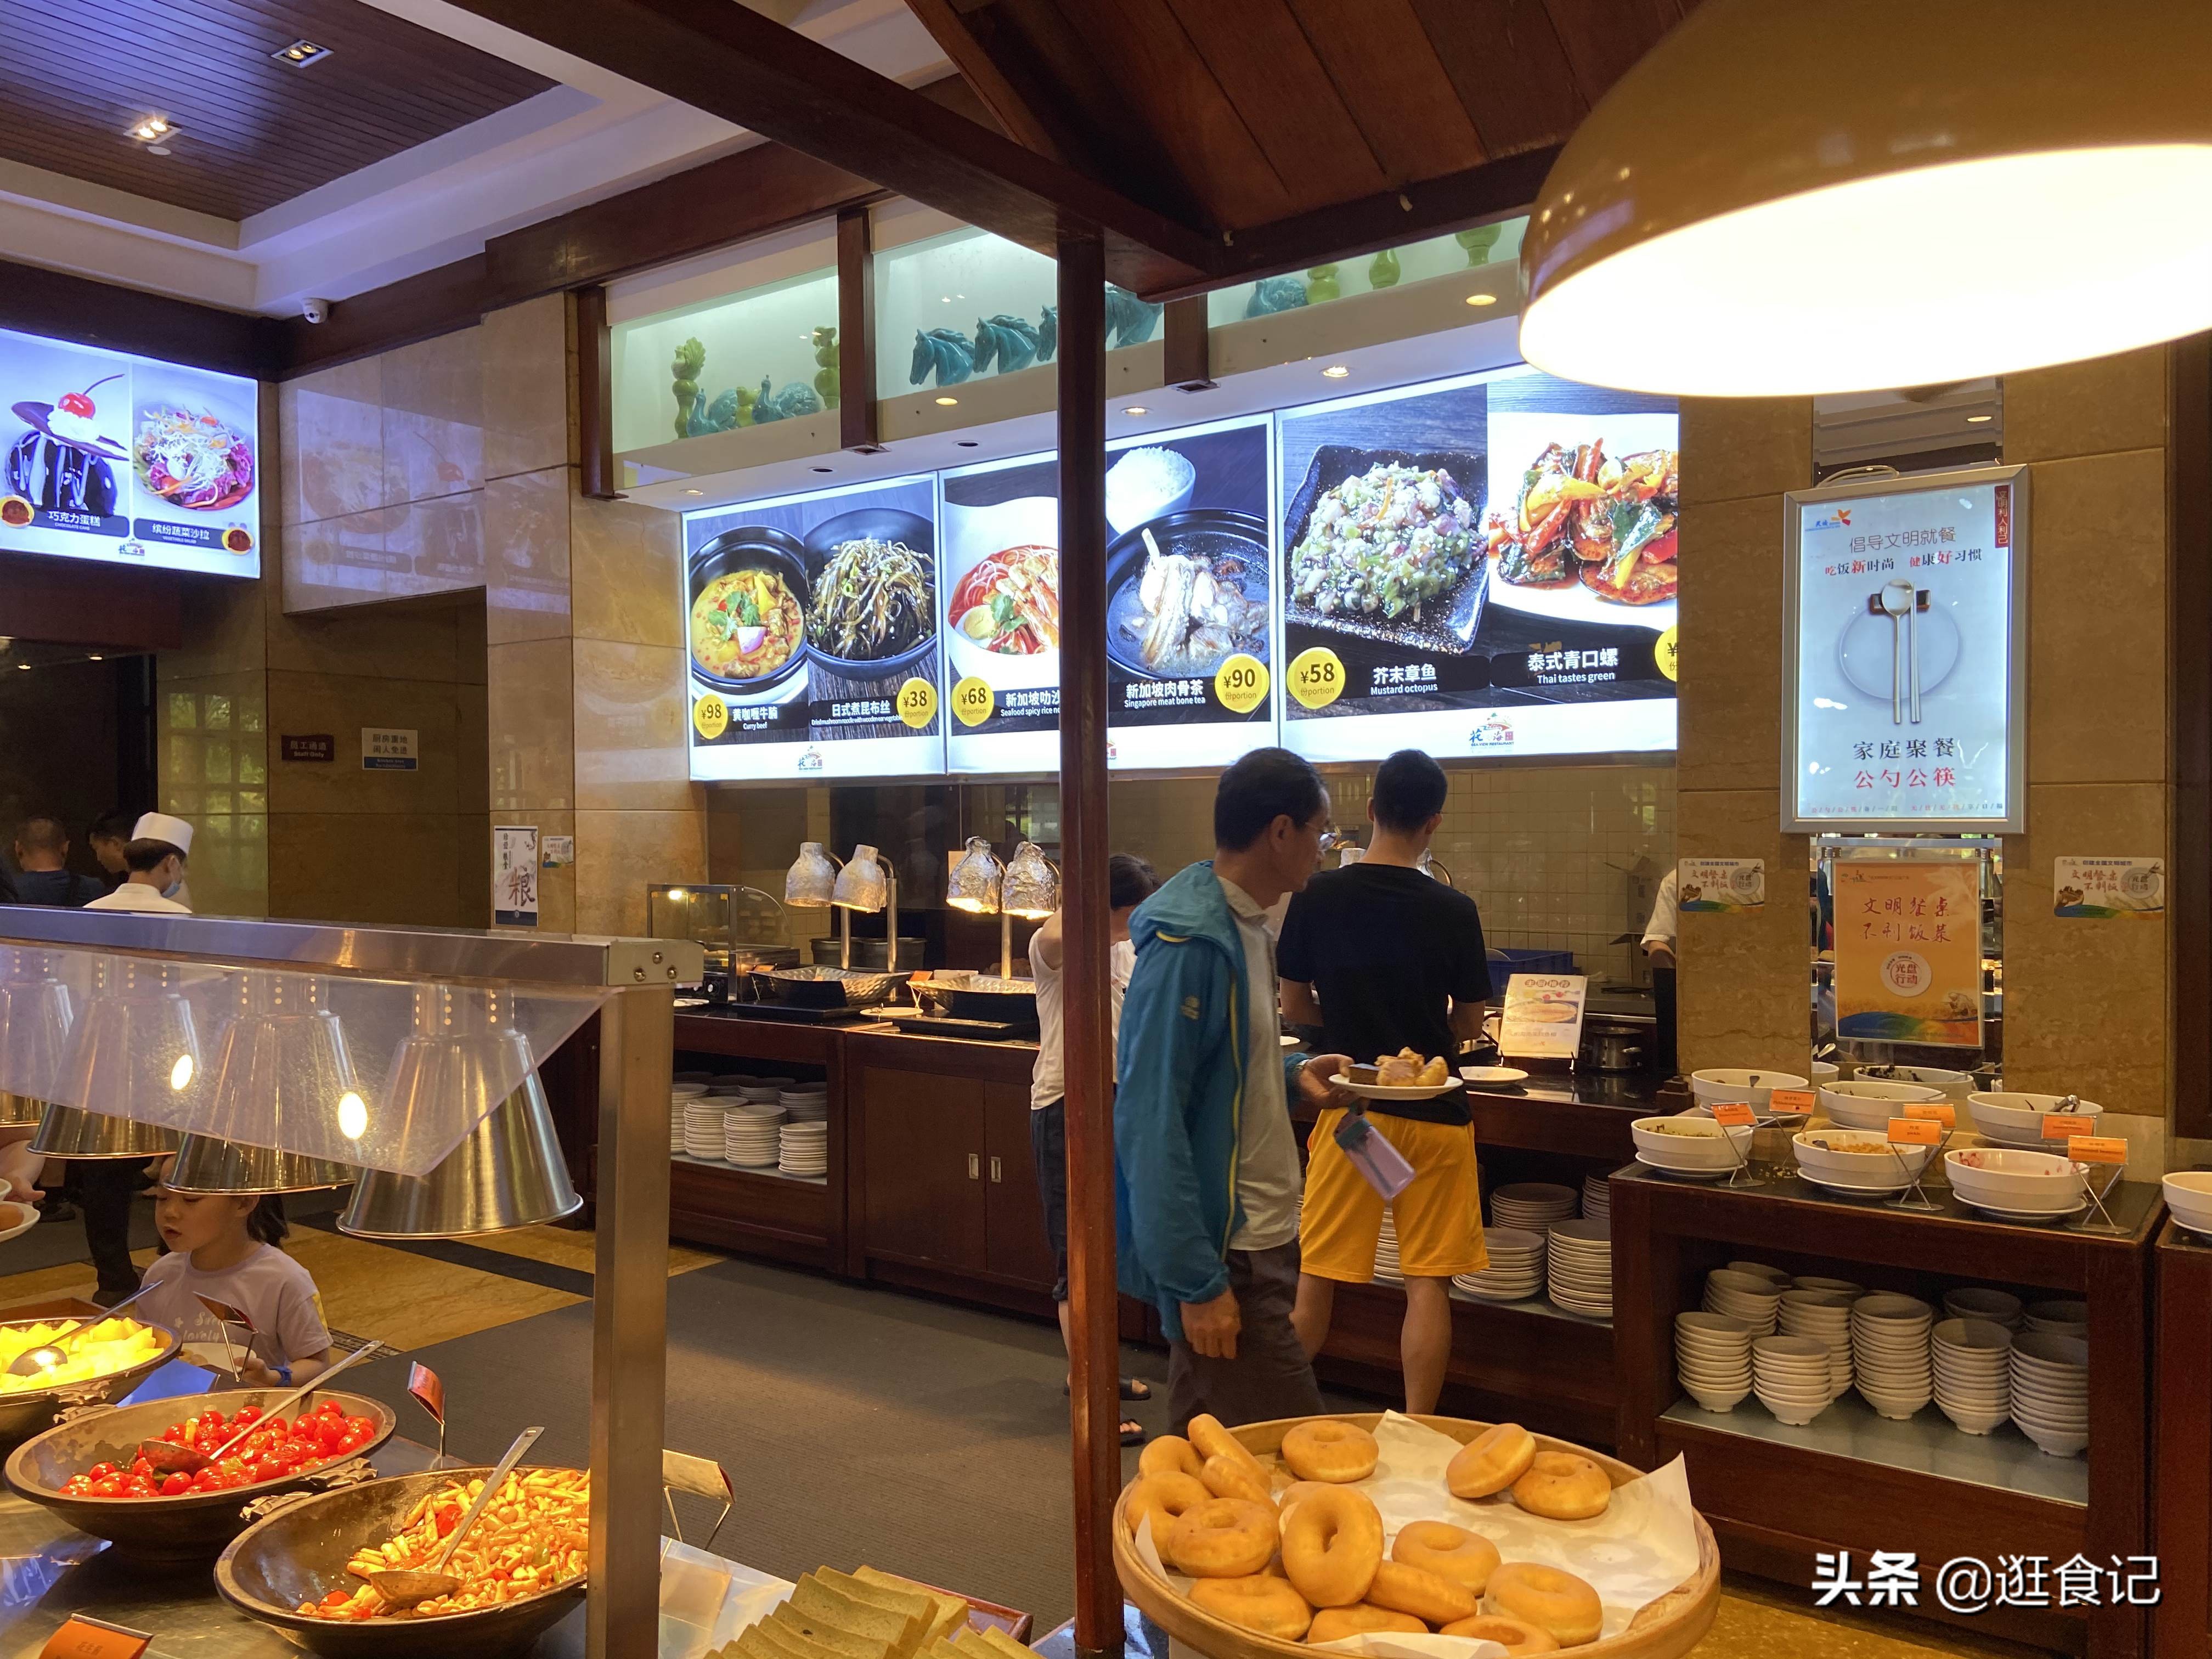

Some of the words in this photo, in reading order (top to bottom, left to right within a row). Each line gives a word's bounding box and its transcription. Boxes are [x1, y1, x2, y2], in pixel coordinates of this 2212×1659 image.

[48, 510, 101, 527] 巧克力蛋糕
[1996, 491, 2008, 544] 文明利人利己
[152, 523, 210, 540] 缤纷蔬菜沙拉
[1849, 527, 1956, 554] 倡导文明就餐
[1825, 558, 1894, 576] 吃饭新时尚
[1910, 548, 1982, 567] 健康好习惯
[1528, 647, 1618, 672] 泰式青口螺
[1223, 668, 1256, 689] ¥90
[1300, 662, 1335, 684] ¥58
[1373, 663, 1437, 685] 芥末章鱼
[1537, 674, 1556, 684] Thai
[1558, 673, 1586, 683] tastes
[1588, 671, 1616, 683] green
[961, 687, 986, 705] ¥68
[1126, 679, 1204, 699] 新加坡肉骨茶
[1370, 684, 1403, 696] Mustard
[1404, 683, 1438, 694] octopus
[832, 699, 891, 717] 日式煮昆布丝
[904, 690, 928, 708] ¥38
[1124, 699, 1157, 709] Singapore
[701, 704, 722, 719] ¥98
[733, 706, 778, 721] 黄咖喱牛腩
[1000, 708, 1025, 717] Seafood
[1025, 707, 1040, 716] spicy
[743, 723, 757, 731] Curry
[1853, 737, 1955, 761] 家庭聚餐
[1854, 767, 1956, 789] 公勺公筷
[1896, 963, 1917, 974] 光盘
[1895, 974, 1917, 985] 行动
